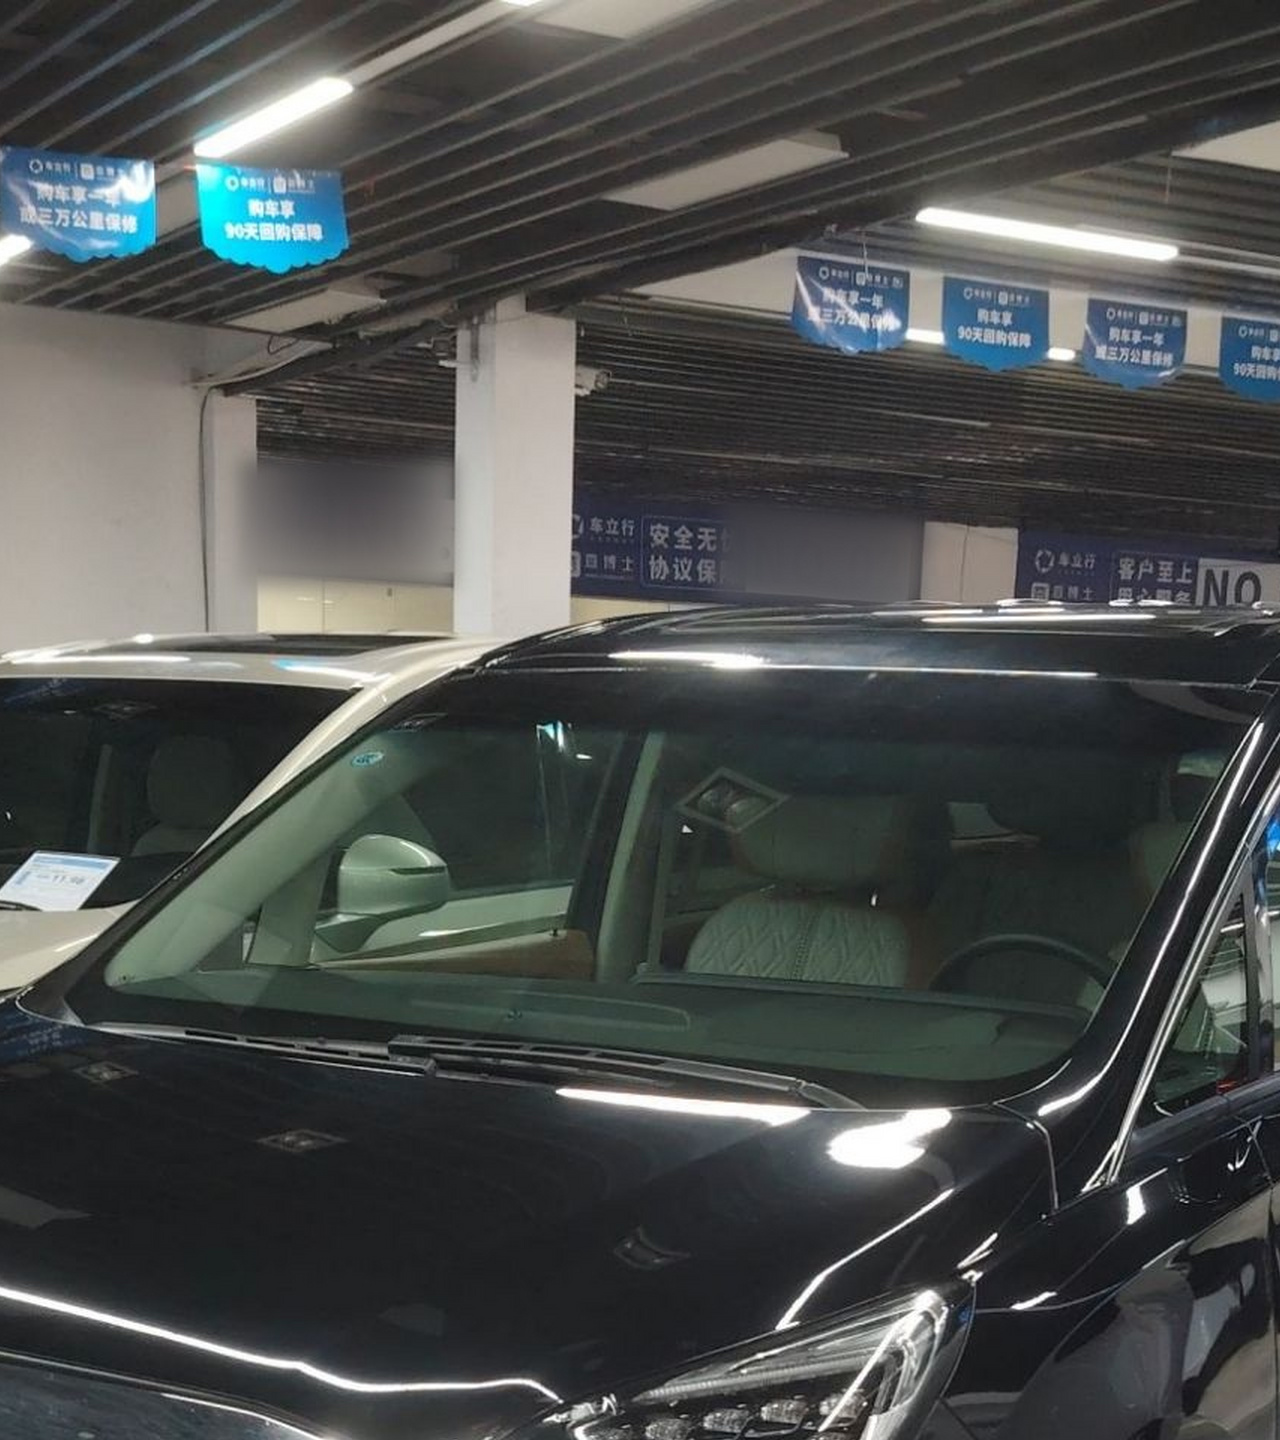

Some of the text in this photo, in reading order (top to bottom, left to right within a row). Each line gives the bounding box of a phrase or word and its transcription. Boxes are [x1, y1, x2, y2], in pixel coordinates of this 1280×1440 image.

[224, 222, 323, 241] 90天回购保障
[589, 517, 635, 536] 车立行
[649, 522, 732, 552] 安全无
[649, 554, 726, 584] 协议保
[1118, 557, 1192, 583] 客户至上
